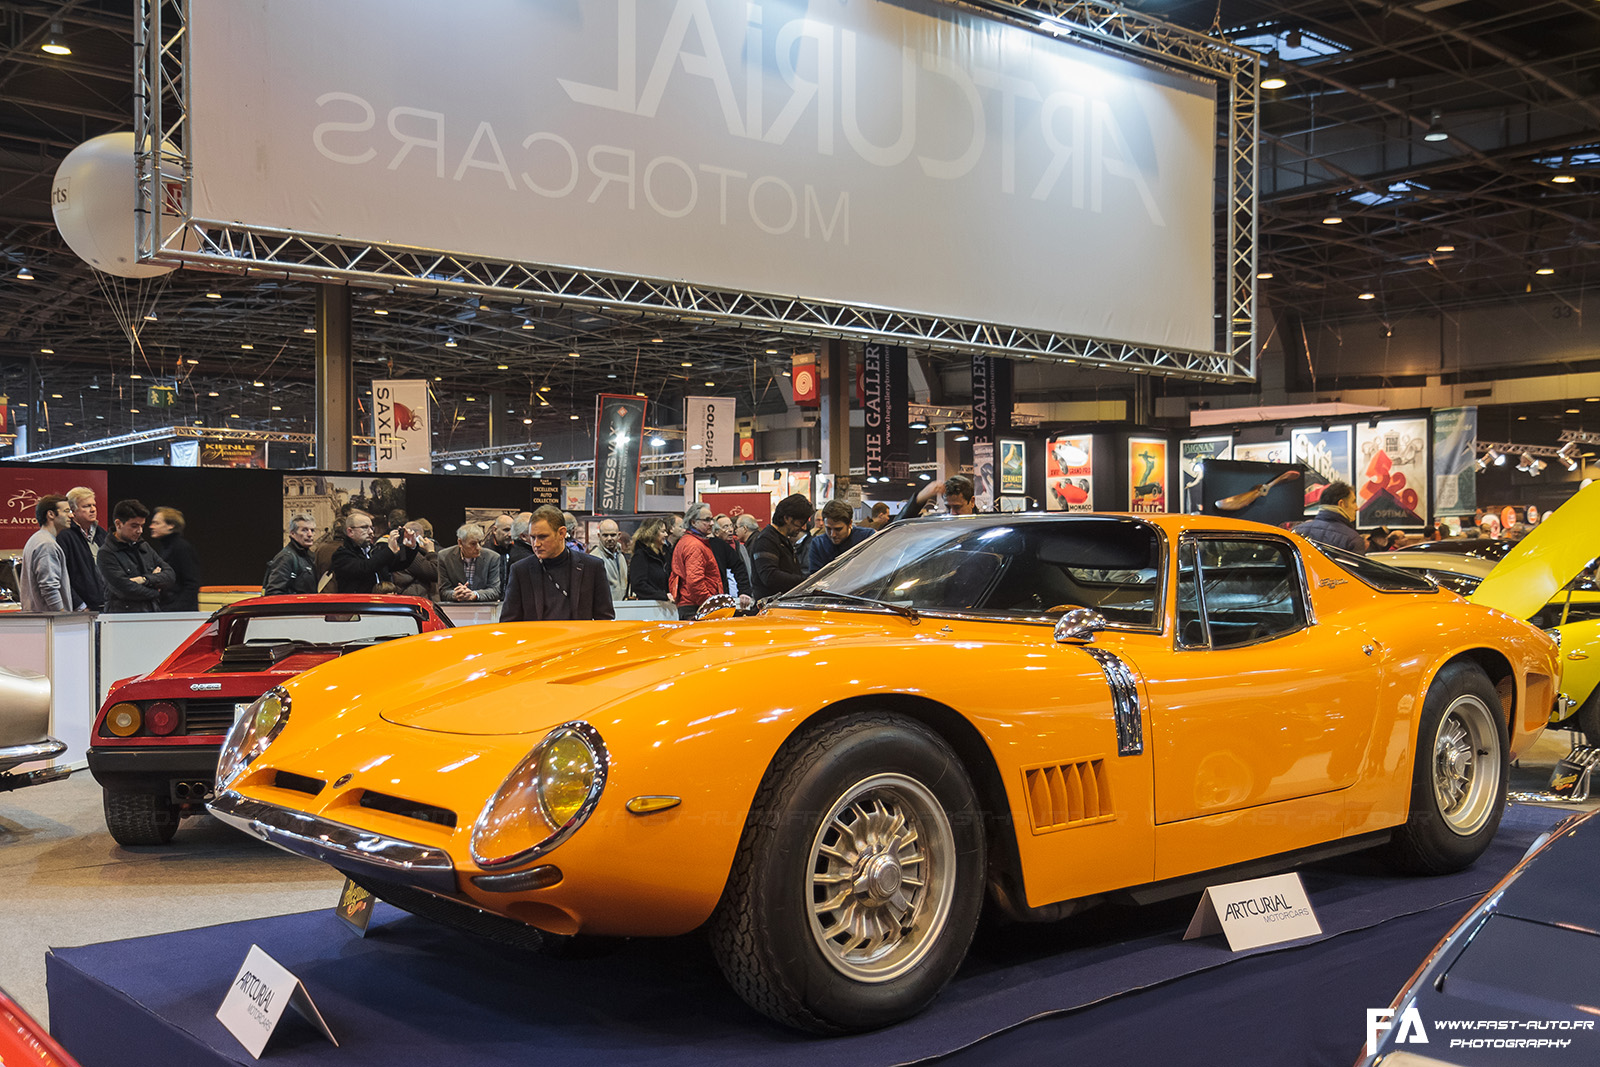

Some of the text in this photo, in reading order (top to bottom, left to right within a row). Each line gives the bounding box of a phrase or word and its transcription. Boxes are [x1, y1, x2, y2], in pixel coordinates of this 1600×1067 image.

[866, 342, 881, 476] THE GALLER
[377, 387, 392, 460] SAXER
[705, 404, 715, 467] COLOURL
[205, 443, 256, 451] KIENLE
[1184, 442, 1215, 453] BIGNAN
[1359, 449, 1418, 512] 520
[1135, 505, 1162, 513] UNIC
[1374, 509, 1407, 518] OPTIMA
[1224, 893, 1292, 921] ARTCURIAL
[1263, 908, 1310, 923] MOTORCARS
[235, 970, 276, 1013] ARTCURIAL
[247, 1003, 272, 1032] MOTORCARS
